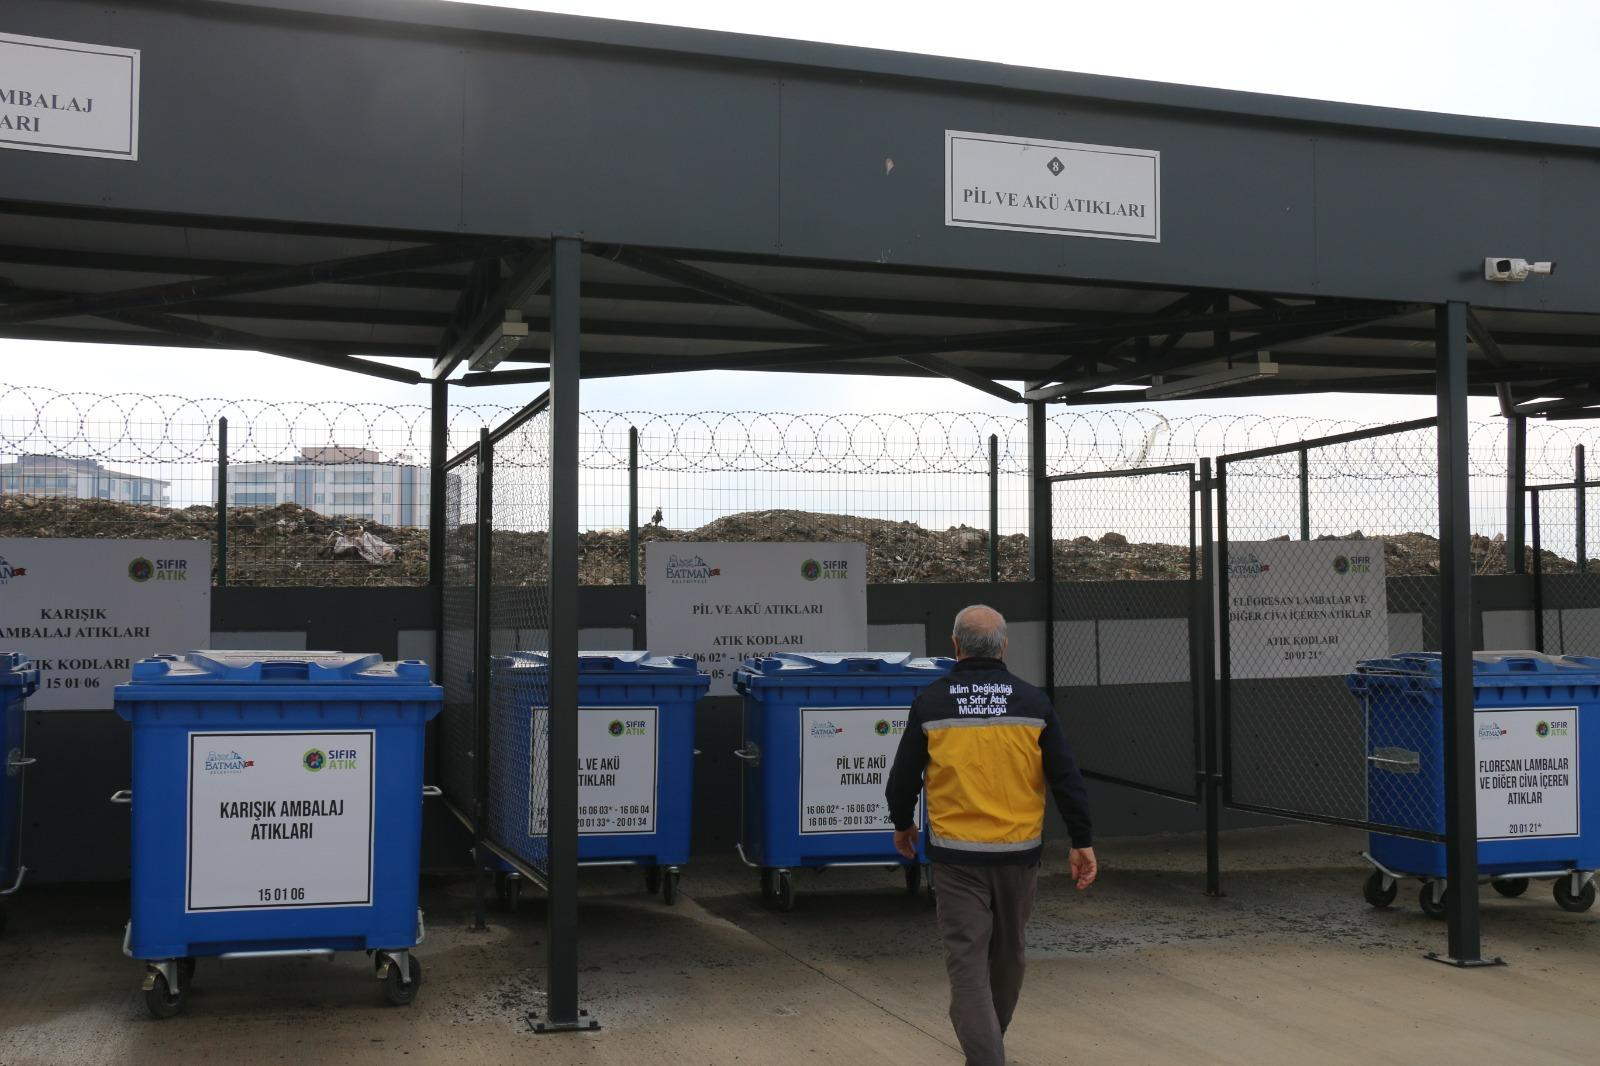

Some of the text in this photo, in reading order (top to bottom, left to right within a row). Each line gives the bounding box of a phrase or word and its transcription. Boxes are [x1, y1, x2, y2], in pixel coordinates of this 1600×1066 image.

[0, 89, 94, 112] MBALAJ
[0, 115, 40, 132] ARI
[1052, 161, 1059, 172] 8
[963, 187, 1145, 218] PİL VE AKÜ ATIKLARI
[156, 559, 187, 569] SIFIR
[823, 561, 848, 569] SIFIR
[157, 570, 187, 580] ATIK
[667, 565, 711, 578] BATMAN
[823, 570, 848, 579] ATIK
[693, 603, 823, 614] PİL VE AKÜ ATIKLARI
[40, 608, 107, 621] KARIŞIK
[75, 626, 151, 638] ATIKLARI
[712, 635, 803, 646] ATIK KODLARI
[1266, 635, 1338, 646] ATIK KODLARI
[25, 659, 129, 670] TIK KODLARI
[47, 678, 100, 689] 15 01 06
[990, 695, 1007, 704] Atık
[958, 705, 1007, 716] Müdürlüğü
[1551, 721, 1568, 729] SIFIR
[329, 750, 357, 759] SIFIR
[205, 760, 246, 770] BATMAN
[328, 760, 357, 770] ATIK
[586, 758, 598, 770] VE
[600, 755, 620, 770] AKÜ
[836, 755, 886, 769] PİL VE AKÜ
[1480, 758, 1568, 773] FLORESAN LAMBALAR
[578, 774, 616, 786] TIKLARI
[840, 773, 882, 785] ATIKLARI
[1480, 773, 1568, 789] VE DİĞER CİVA İÇEREN
[1508, 792, 1542, 805] ATIKLAR
[220, 800, 344, 820] KARIŞIK AMBALAJ
[579, 806, 587, 815] 16
[589, 806, 598, 815] 06
[620, 805, 628, 814] 16
[630, 805, 639, 814] 06
[640, 805, 649, 814] 04
[807, 805, 815, 815] 16
[816, 805, 825, 814] 06
[847, 804, 855, 813] 16
[856, 804, 865, 813] 06
[586, 818, 595, 827] 01
[617, 818, 626, 827] 20
[628, 817, 636, 826] 01
[638, 817, 647, 826] 34
[809, 817, 817, 826] 16
[829, 816, 838, 825] 05
[844, 816, 852, 825] 20
[854, 816, 862, 825] 01
[251, 823, 313, 840] ATIKLARI
[1510, 824, 1518, 834] 20
[1520, 823, 1528, 833] 01
[258, 887, 305, 901] 15 01 06
